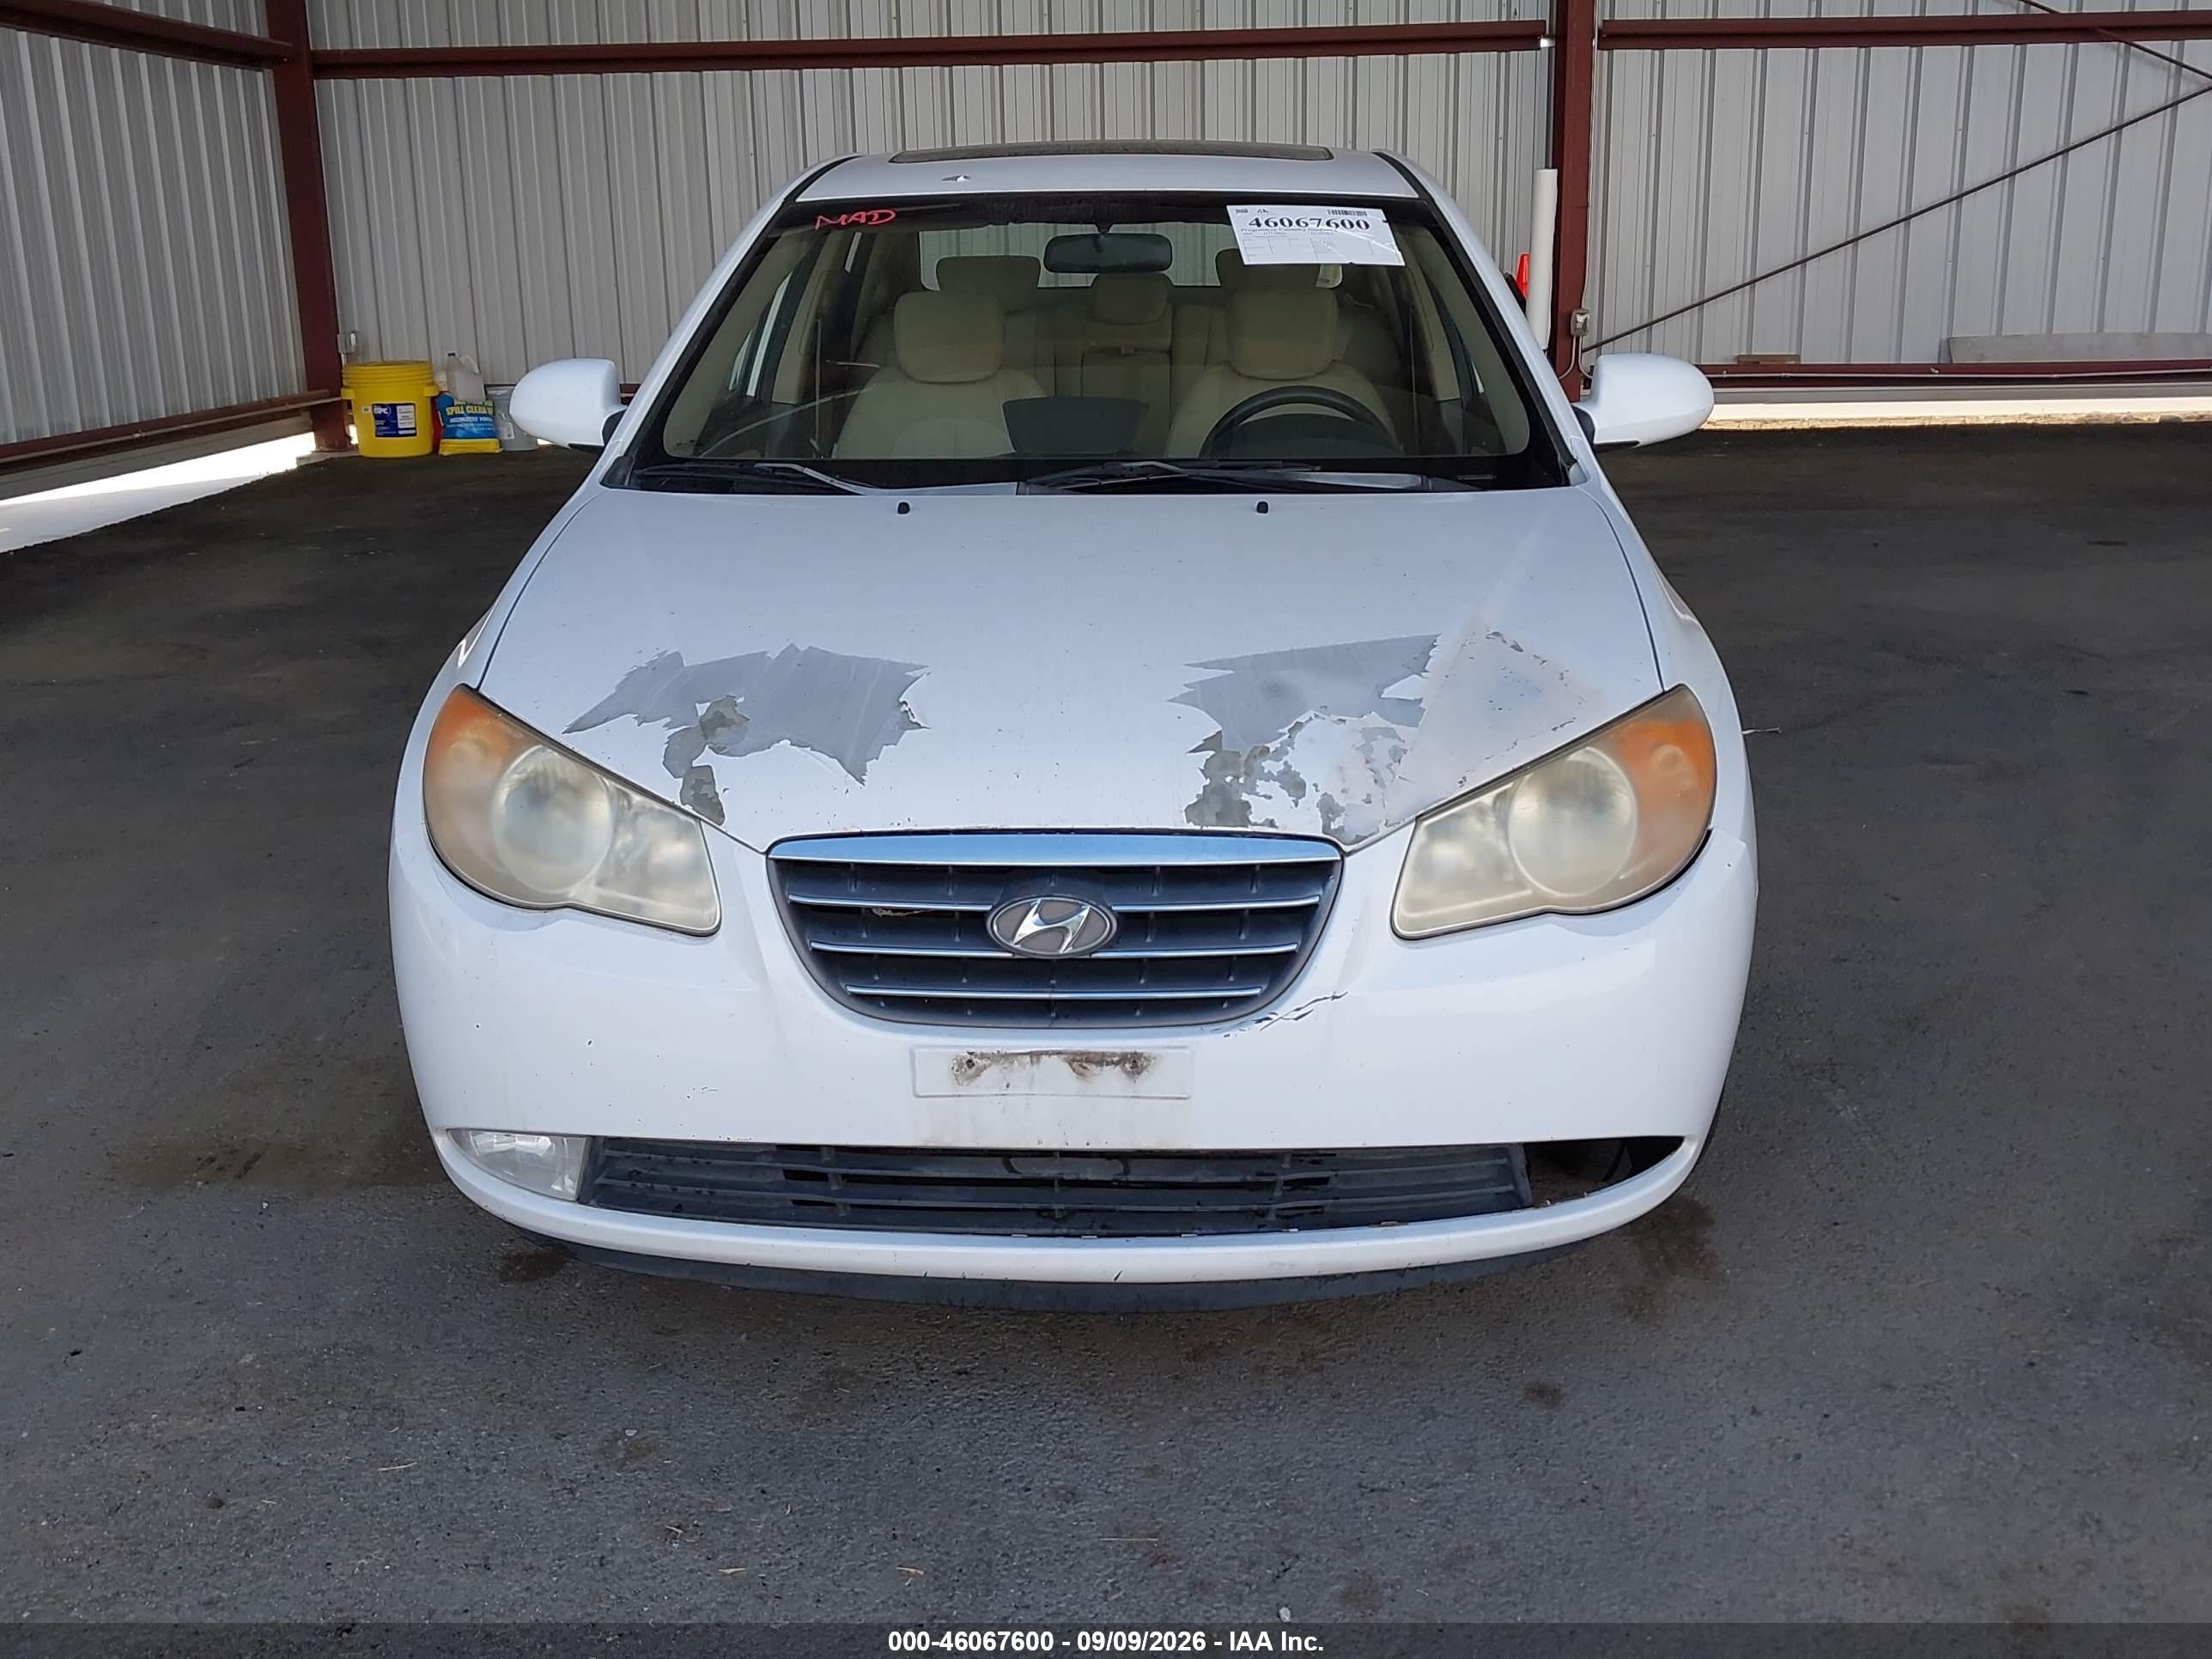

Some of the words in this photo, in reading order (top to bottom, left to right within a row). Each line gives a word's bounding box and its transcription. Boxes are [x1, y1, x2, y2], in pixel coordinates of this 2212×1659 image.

[814, 209, 896, 231] MAD
[1249, 216, 1370, 230] 46067600
[446, 405, 465, 416] SPILL
